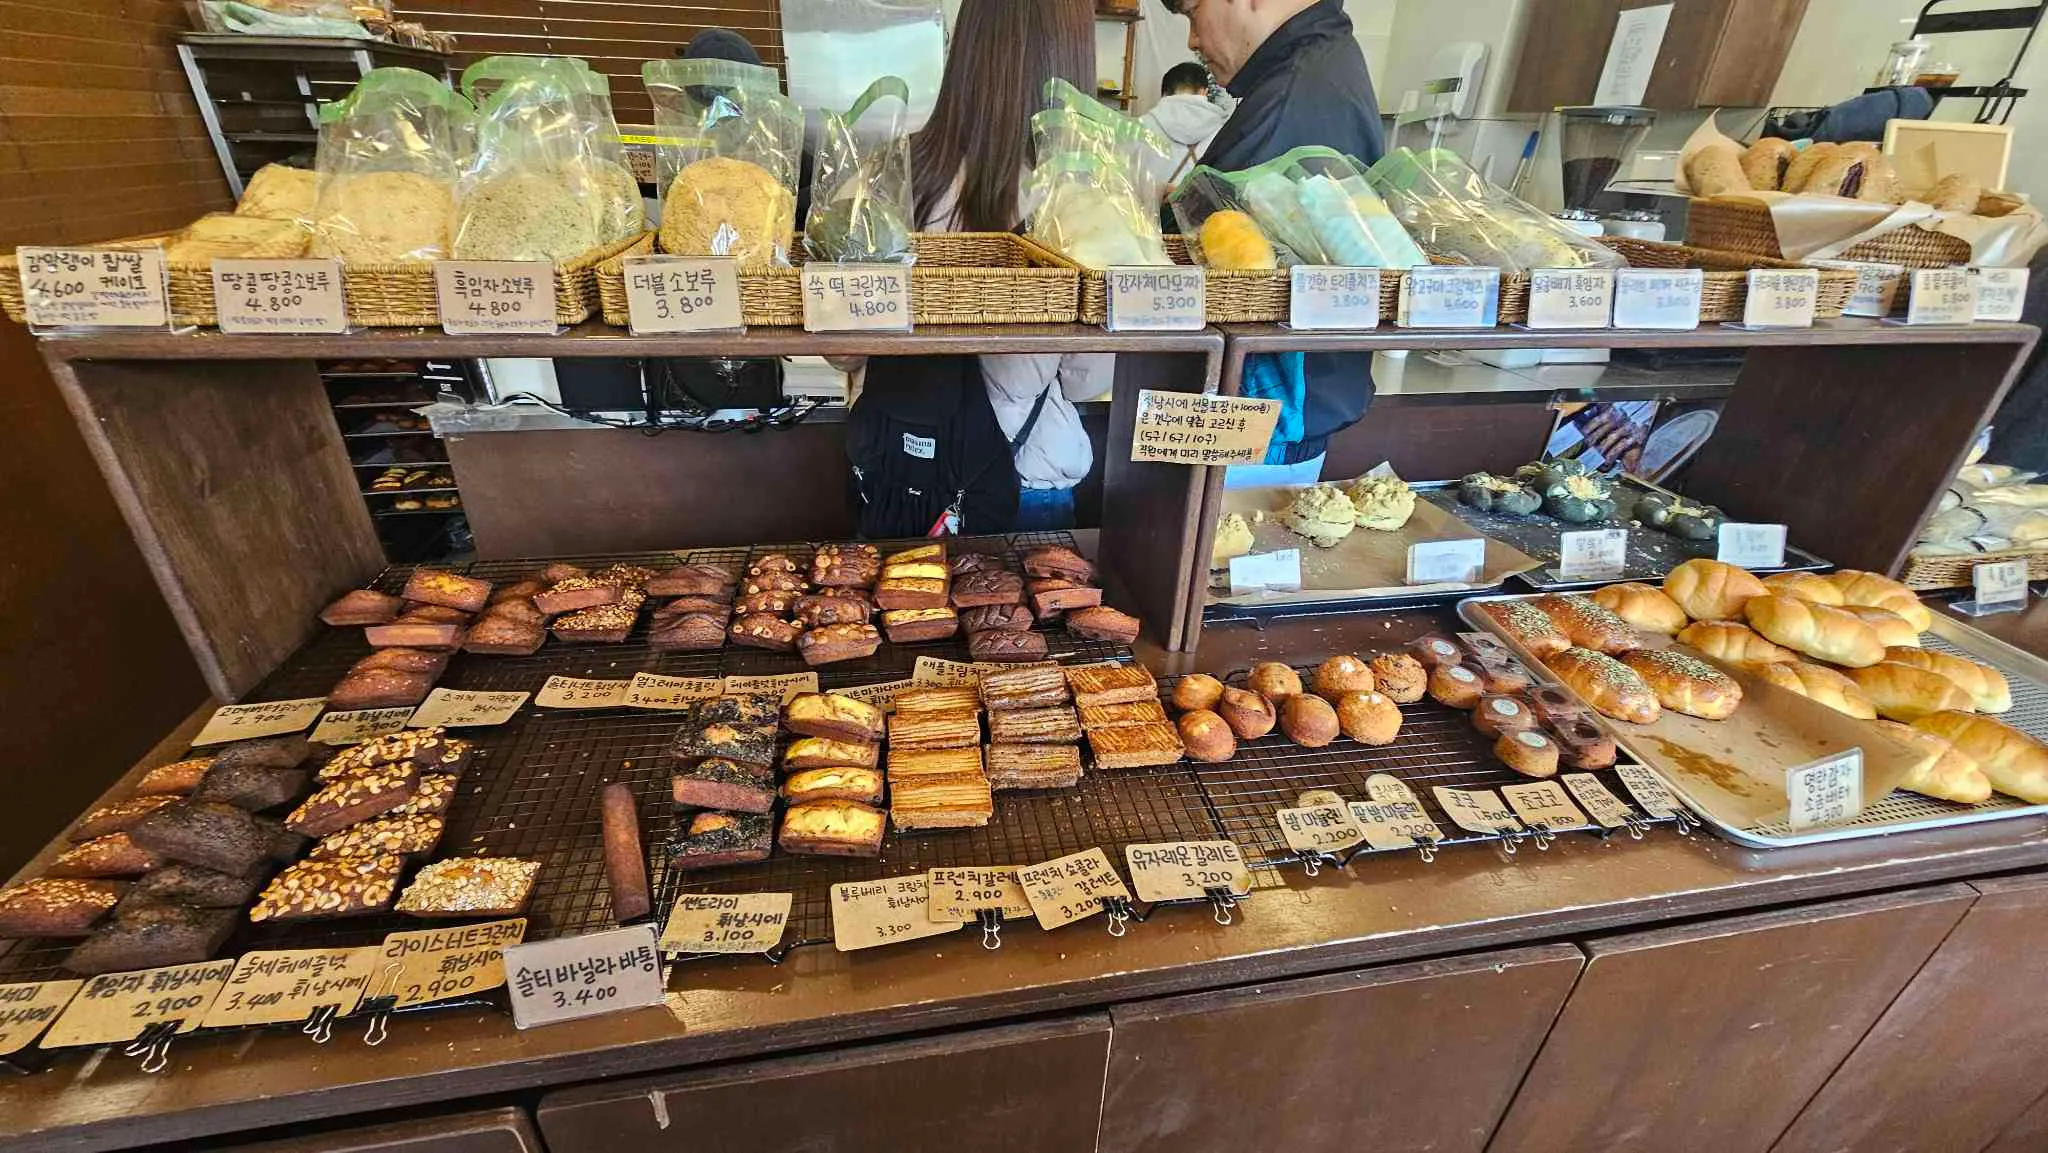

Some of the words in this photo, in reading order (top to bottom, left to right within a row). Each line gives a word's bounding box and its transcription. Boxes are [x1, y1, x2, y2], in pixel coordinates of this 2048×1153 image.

[102, 252, 144, 274] 찹쌀
[99, 274, 147, 290] 케이크
[850, 274, 902, 298] 크림치즈
[245, 295, 302, 312] 4.800
[468, 300, 522, 317] 4.800
[656, 295, 714, 320] 3.800
[849, 300, 897, 317] 4.800
[1568, 296, 1602, 308] 3.600
[1180, 449, 1198, 458] 미리
[562, 690, 612, 700] 3.200
[1472, 808, 1511, 822] 1.500
[1312, 829, 1358, 845] 2.200
[1074, 870, 1120, 896] 갈레트
[1182, 870, 1233, 887] 3.200
[839, 885, 888, 903] 블루베리
[955, 889, 1003, 902] 2.900
[1060, 896, 1100, 919] 3.200
[716, 912, 783, 929] 휘낭시에
[703, 929, 755, 943] 3.100
[876, 923, 912, 938] 3.300
[148, 963, 233, 993] 휘낭시에
[225, 990, 282, 1012] 3.400
[288, 974, 368, 999] 휘낭시에
[406, 975, 475, 1003] 2.900
[552, 985, 618, 1008] 3.400
[131, 995, 203, 1018] 2.900
